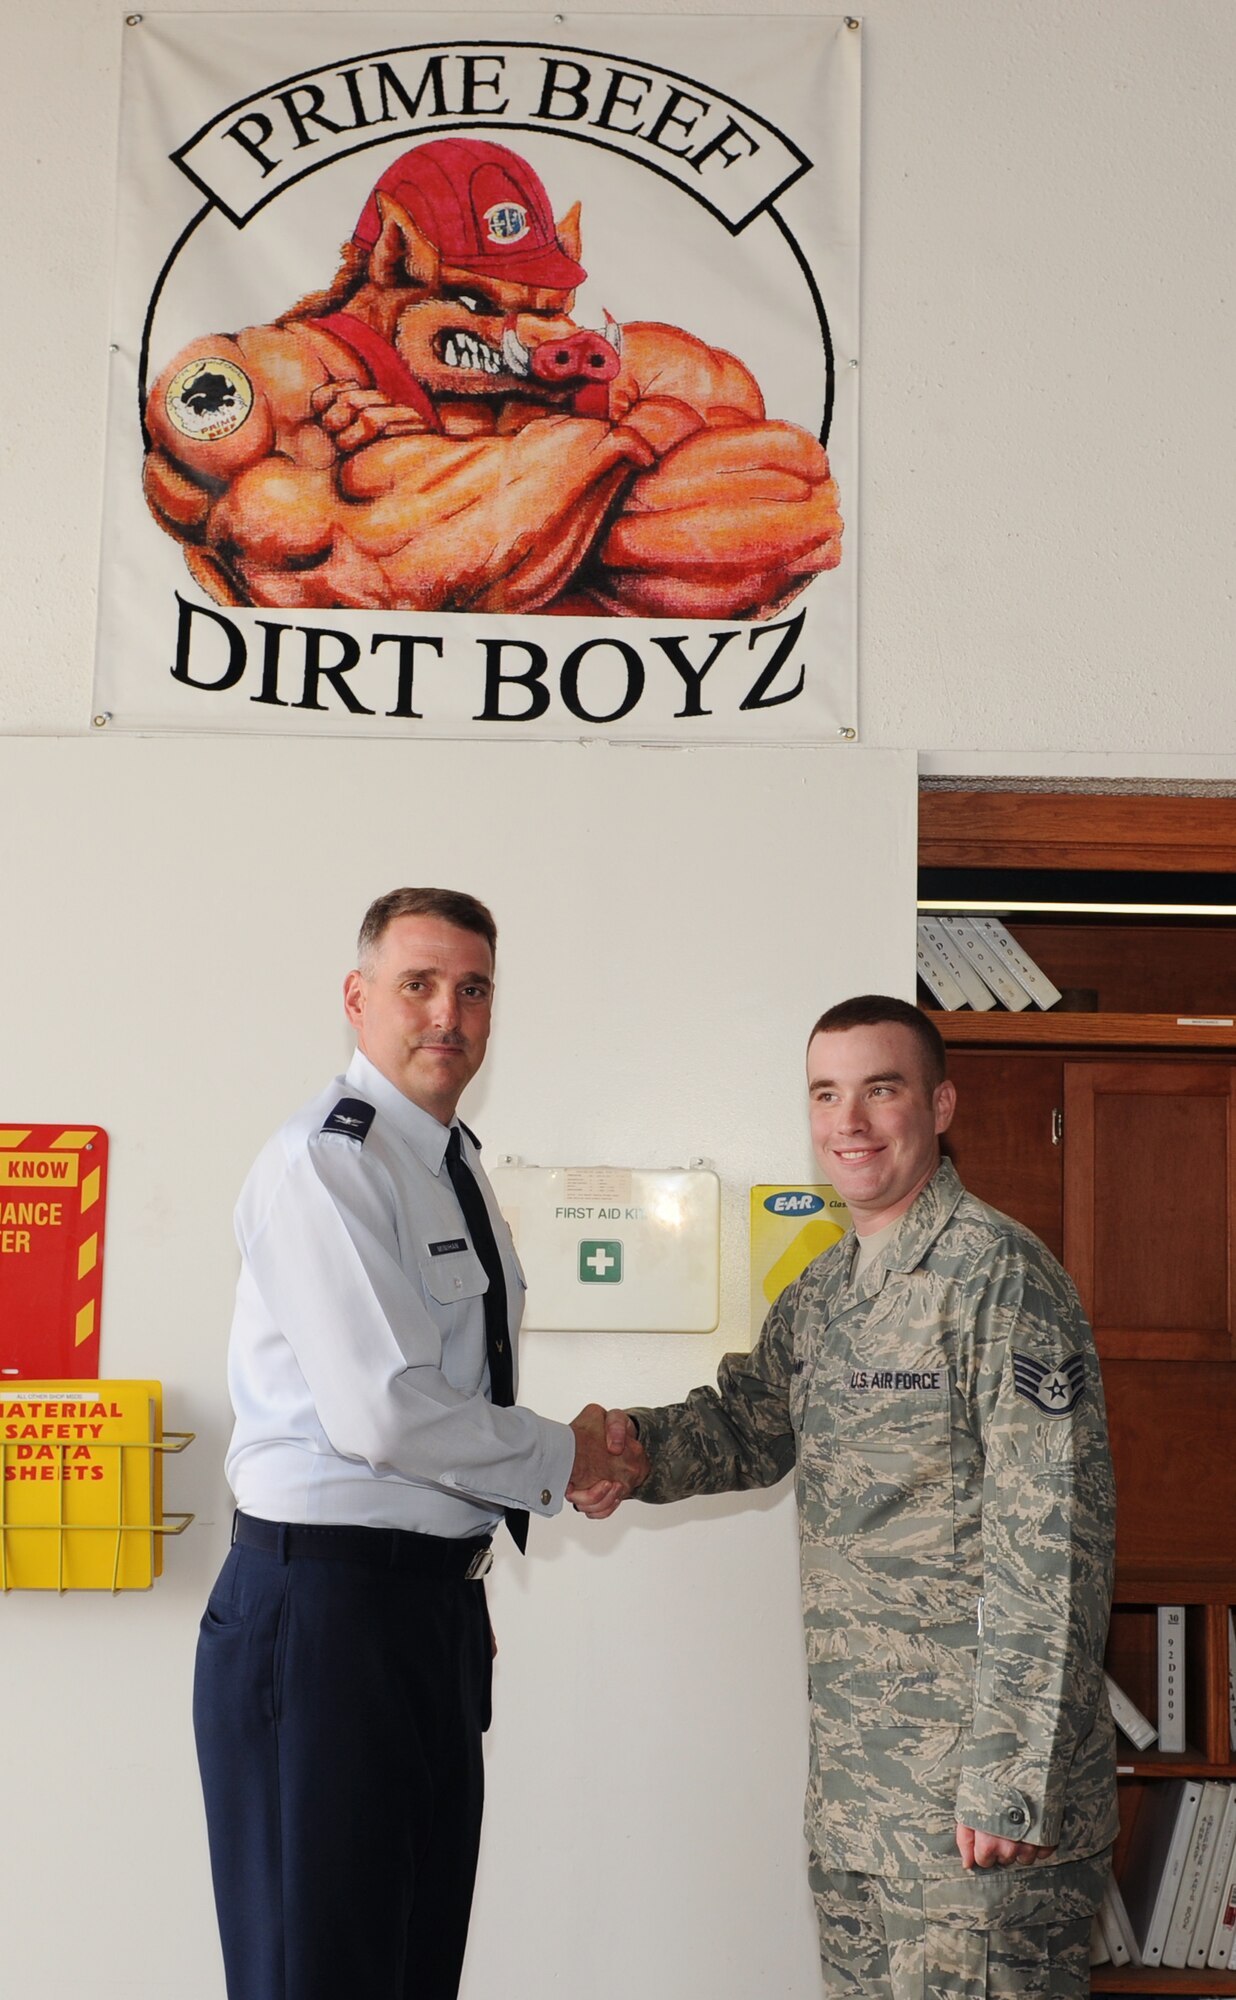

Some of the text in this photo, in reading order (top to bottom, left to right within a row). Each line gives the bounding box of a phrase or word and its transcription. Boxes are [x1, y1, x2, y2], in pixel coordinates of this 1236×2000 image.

[220, 55, 759, 179] PRIME BEEF
[170, 590, 807, 722] DIRT BOYZ
[8, 1161, 68, 1178] KNOW
[0, 1203, 62, 1225] ANCE
[555, 1207, 594, 1219] FIRST
[598, 1208, 621, 1219] AID
[0, 1231, 31, 1253] ER
[850, 1372, 940, 1389] U.S. AIR FORCE
[0, 1403, 123, 1418] ATERIAL
[5, 1424, 104, 1439] SAFETY
[17, 1444, 92, 1459] DATA
[5, 1466, 104, 1480] SHEETS
